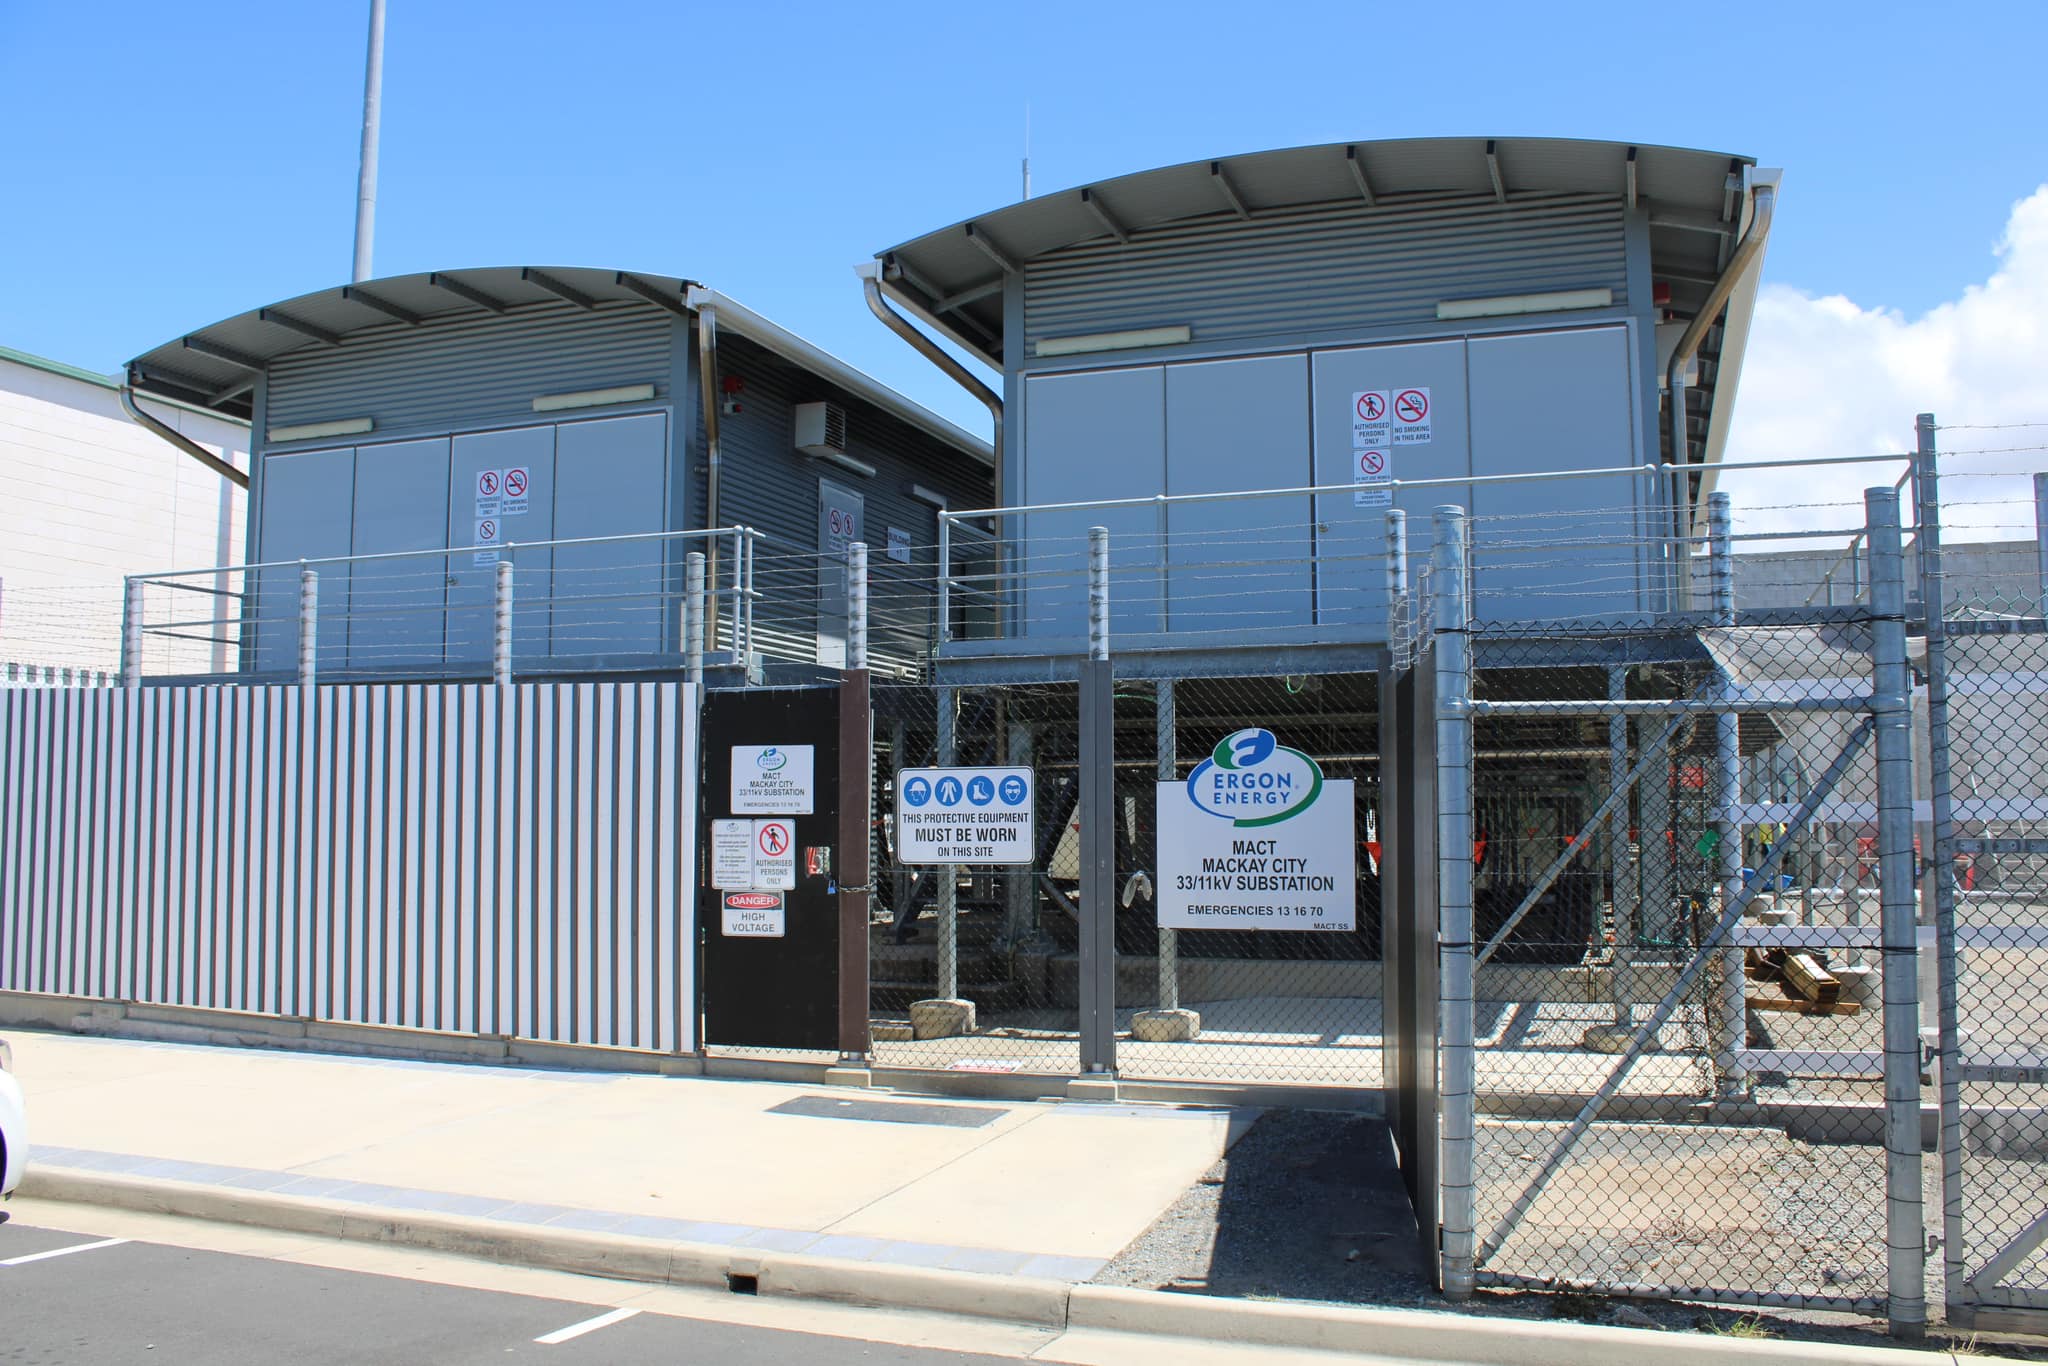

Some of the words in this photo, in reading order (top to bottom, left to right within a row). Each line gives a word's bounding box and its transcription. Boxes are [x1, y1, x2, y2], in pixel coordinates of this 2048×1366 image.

[1404, 425, 1430, 433] SMOKING
[762, 772, 781, 780] MACT
[1214, 773, 1291, 789] ERGON
[750, 780, 778, 788] MACKAY
[778, 780, 794, 788] CITY
[739, 788, 763, 796] 33/11kV
[763, 788, 804, 796] SUBSTATION
[1213, 792, 1290, 804] ENERGY
[903, 813, 922, 823] THIS
[924, 813, 975, 823] PROTECTIVE
[978, 812, 1029, 823] EQUIPMENT
[915, 828, 952, 842] MUST
[956, 828, 972, 842] BE
[976, 828, 1017, 842] WORN
[938, 847, 950, 857] ON
[952, 847, 972, 857] THIS
[974, 847, 993, 857] SITE
[1232, 840, 1277, 855] MACT
[756, 859, 792, 867] AUTHORISED
[1202, 858, 1269, 873] MACKAY
[1272, 858, 1307, 873] CITY
[760, 868, 788, 876] PERSONS
[1176, 875, 1232, 890] 33/11kV
[1236, 876, 1334, 891] SUBSTATION
[1187, 905, 1273, 916] EMERGENCIES
[1278, 906, 1290, 916] 13
[1294, 907, 1306, 916] 16
[1310, 907, 1323, 916] 70
[741, 912, 765, 921] HIGH
[732, 923, 775, 932] VOLTAGE
